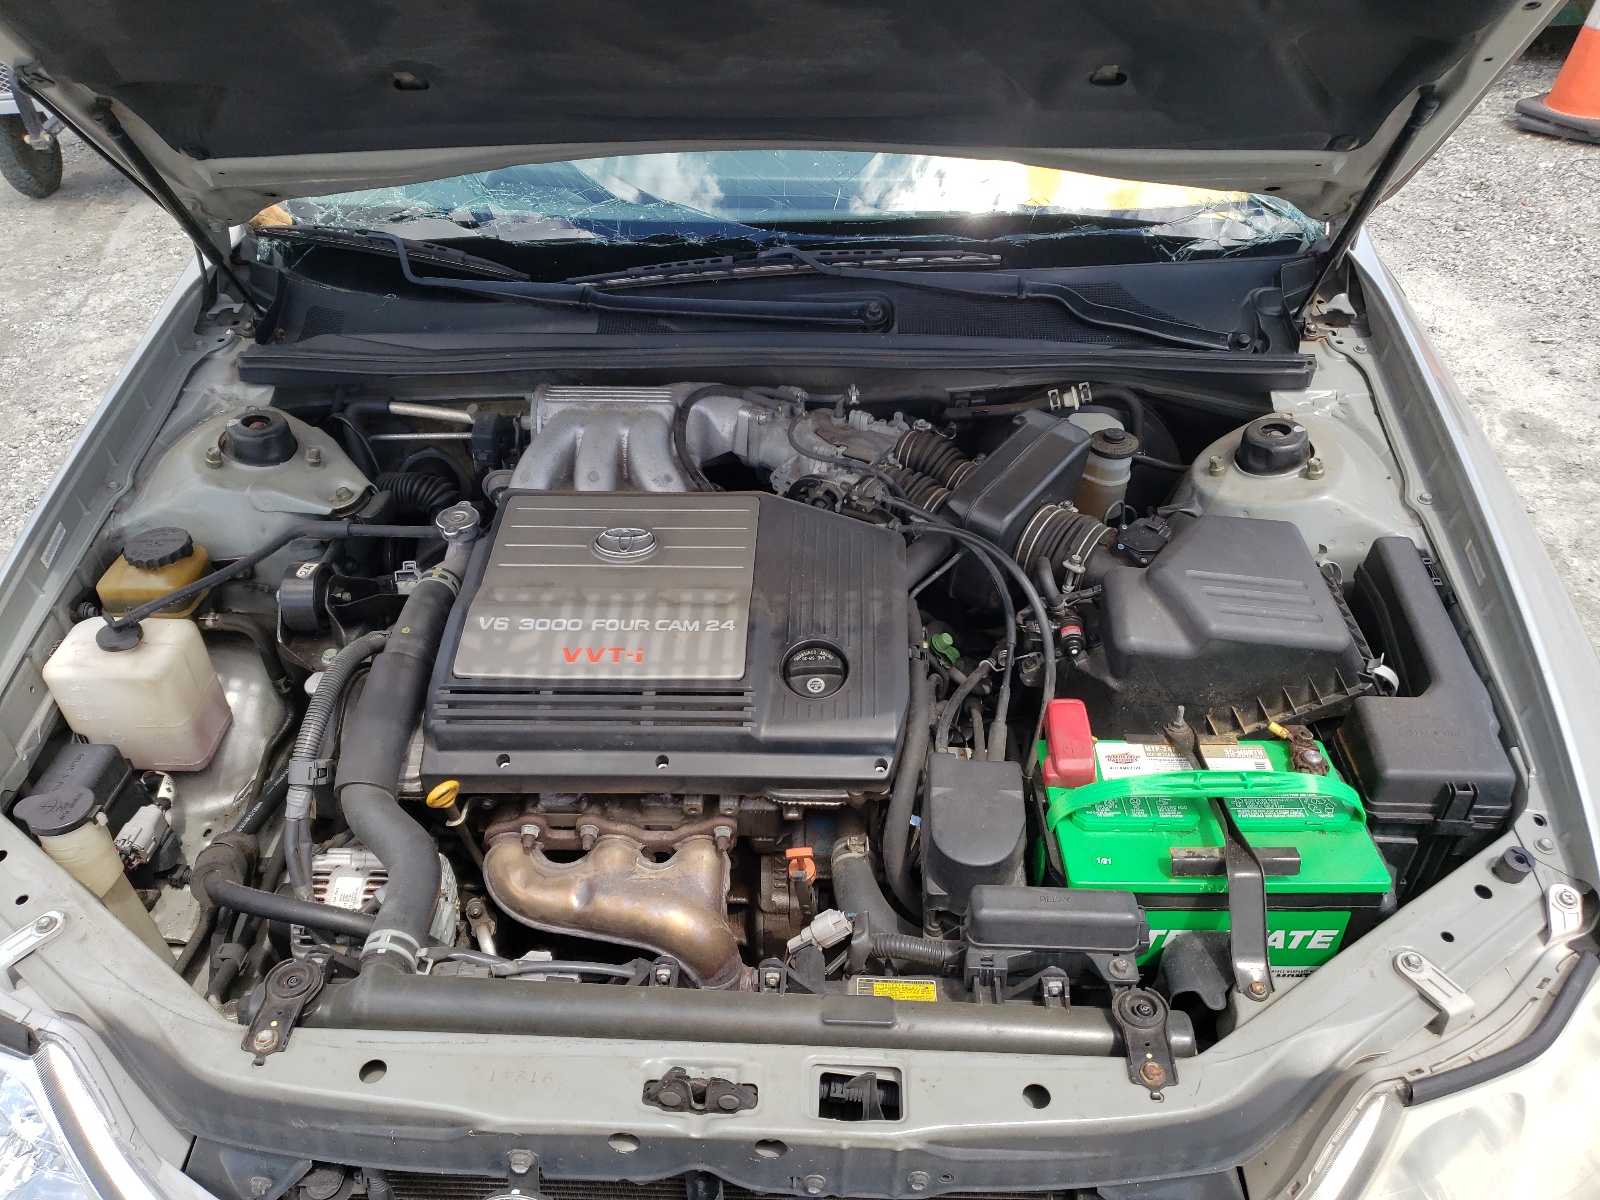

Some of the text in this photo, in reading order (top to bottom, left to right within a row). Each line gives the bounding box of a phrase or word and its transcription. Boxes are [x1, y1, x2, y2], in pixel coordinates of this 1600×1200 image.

[478, 616, 736, 632] V6 3000 FOUR CAM 24
[562, 647, 644, 663] VVT-i
[1096, 857, 1112, 865] 1/21
[1039, 895, 1071, 903] RELAY
